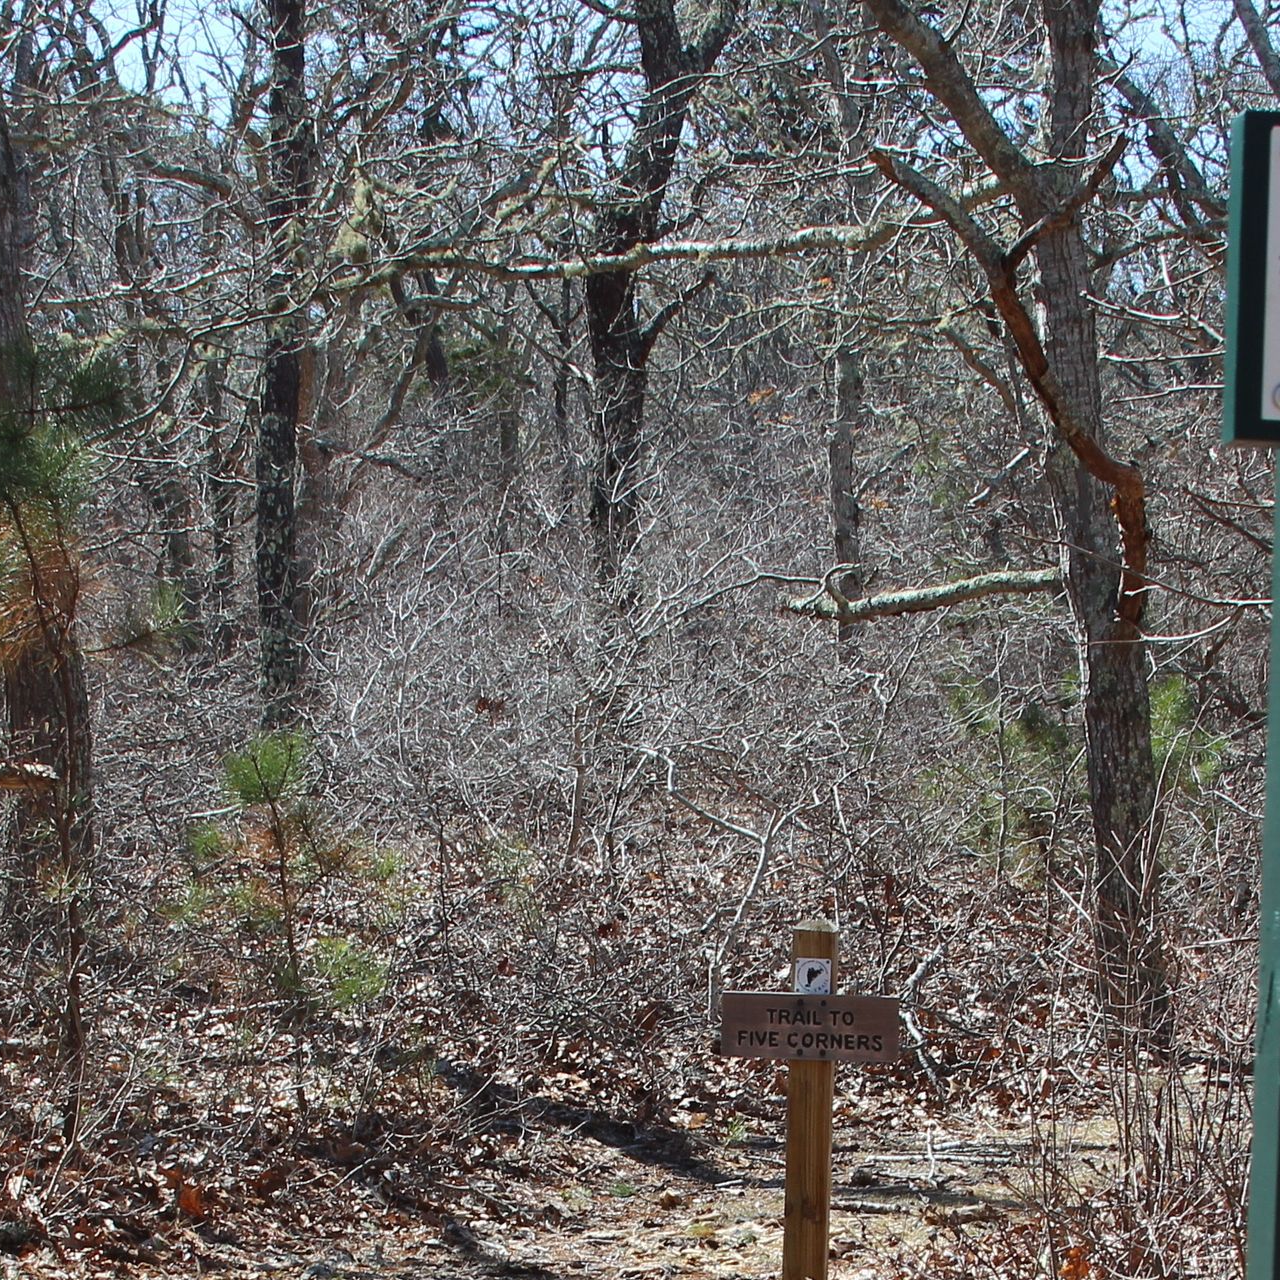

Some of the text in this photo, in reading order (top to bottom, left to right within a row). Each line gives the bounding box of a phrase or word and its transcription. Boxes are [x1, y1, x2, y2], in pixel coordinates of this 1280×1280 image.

[766, 1008, 855, 1026] TRAIL TO
[737, 1030, 883, 1052] FIVE CORNERS
